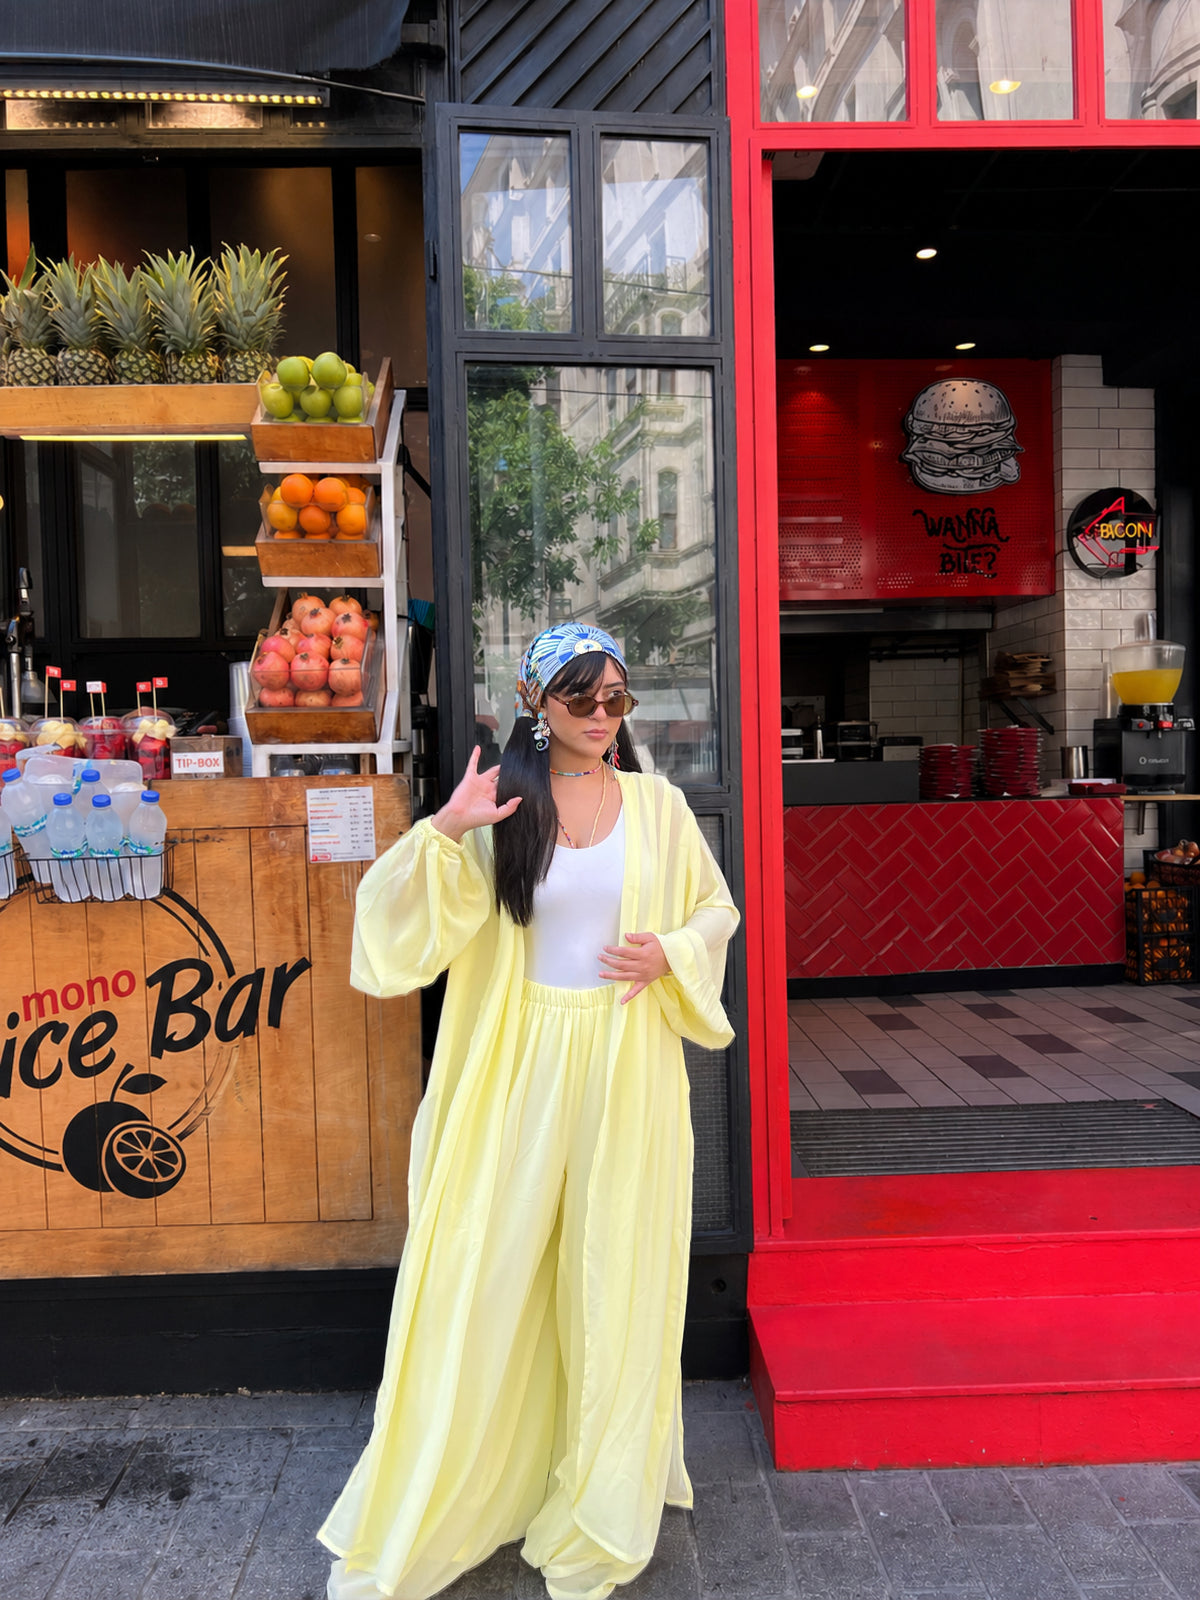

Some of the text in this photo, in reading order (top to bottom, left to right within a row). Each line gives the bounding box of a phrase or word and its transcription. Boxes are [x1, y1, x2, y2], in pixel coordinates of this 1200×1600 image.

[912, 507, 1010, 543] WANNA
[1100, 521, 1153, 540] BACON
[939, 543, 1001, 578] BITE?
[176, 757, 220, 769] TIP-BOX
[22, 969, 136, 1022] mono
[146, 957, 312, 1059] Bar
